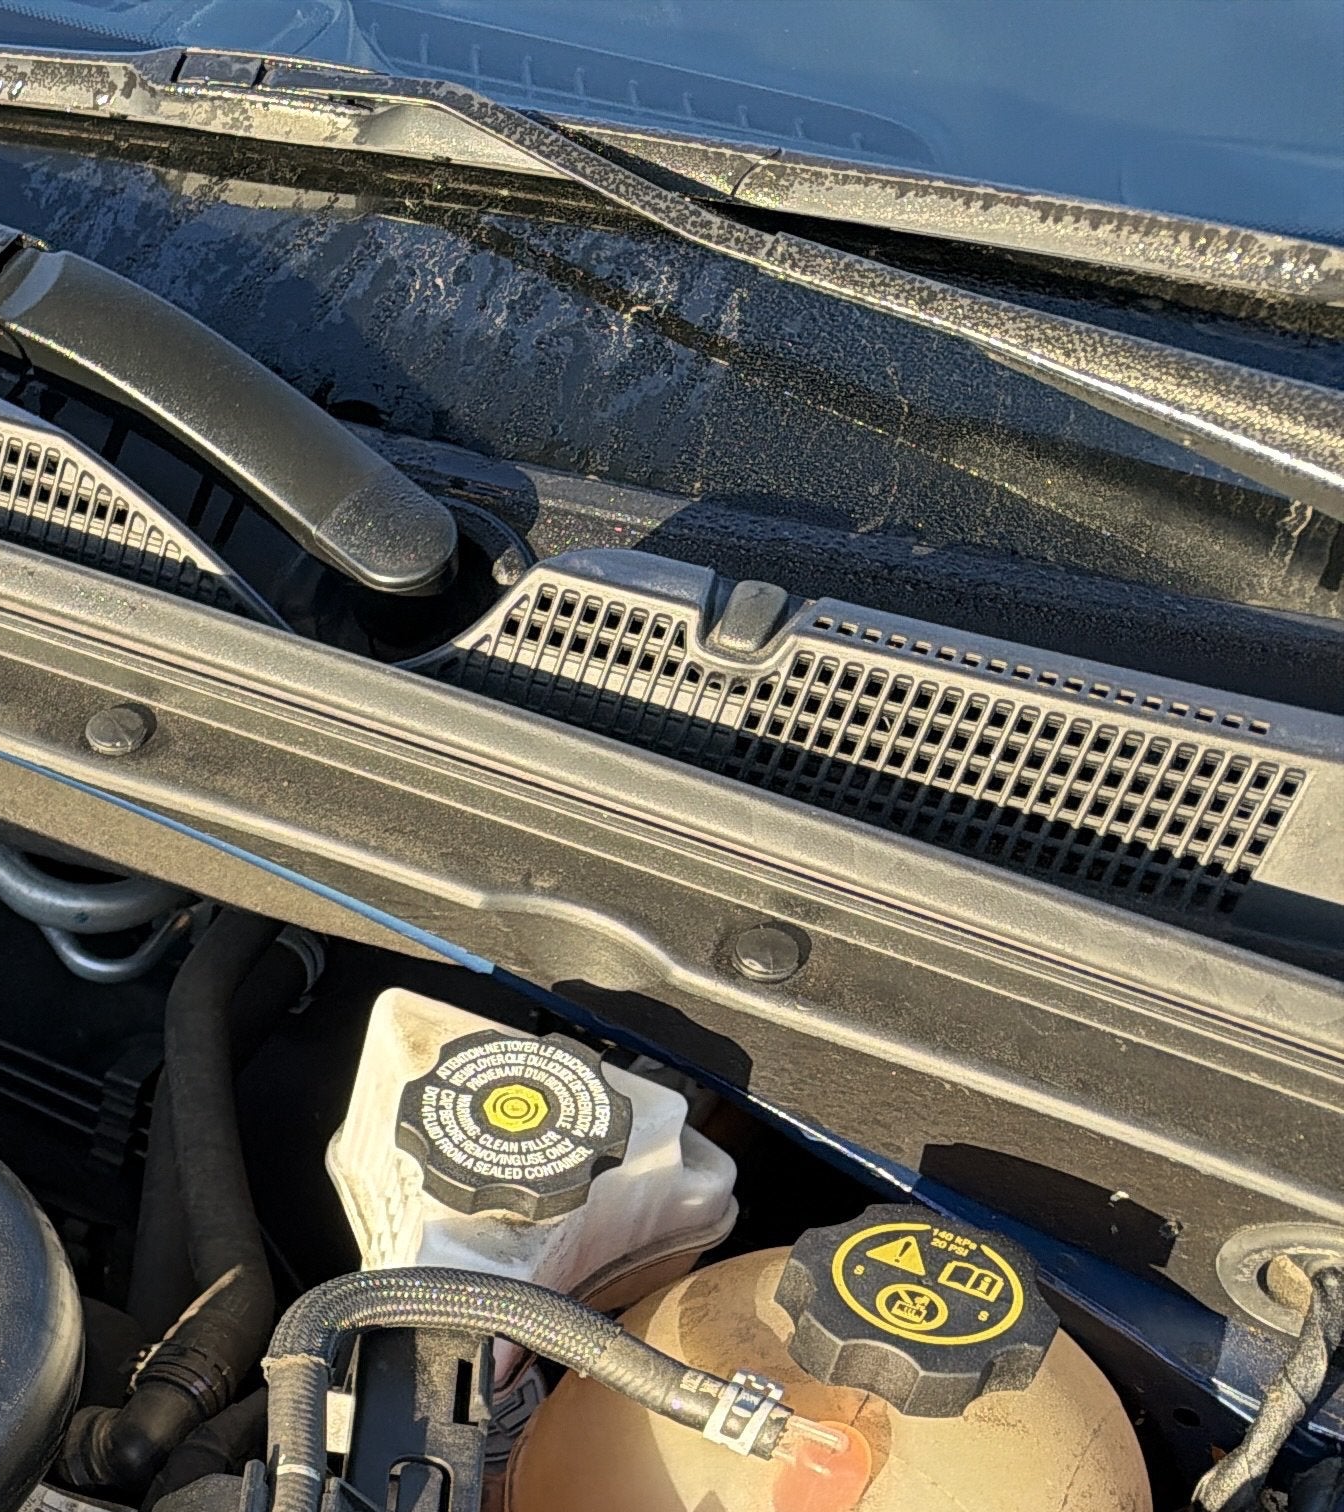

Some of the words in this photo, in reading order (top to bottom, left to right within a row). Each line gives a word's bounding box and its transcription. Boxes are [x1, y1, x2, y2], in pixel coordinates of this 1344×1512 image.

[539, 1045, 557, 1058] LE
[438, 1089, 457, 1110] CAP
[438, 1109, 468, 1146] BEFORE
[478, 1133, 519, 1154] CLEAN
[520, 1130, 563, 1154] FILLER
[435, 1137, 469, 1165] FROM
[462, 1157, 476, 1170] A
[473, 1160, 523, 1180] SEALED
[521, 1151, 548, 1166] USE
[930, 1237, 946, 1250] 20
[932, 1228, 954, 1243] 140
